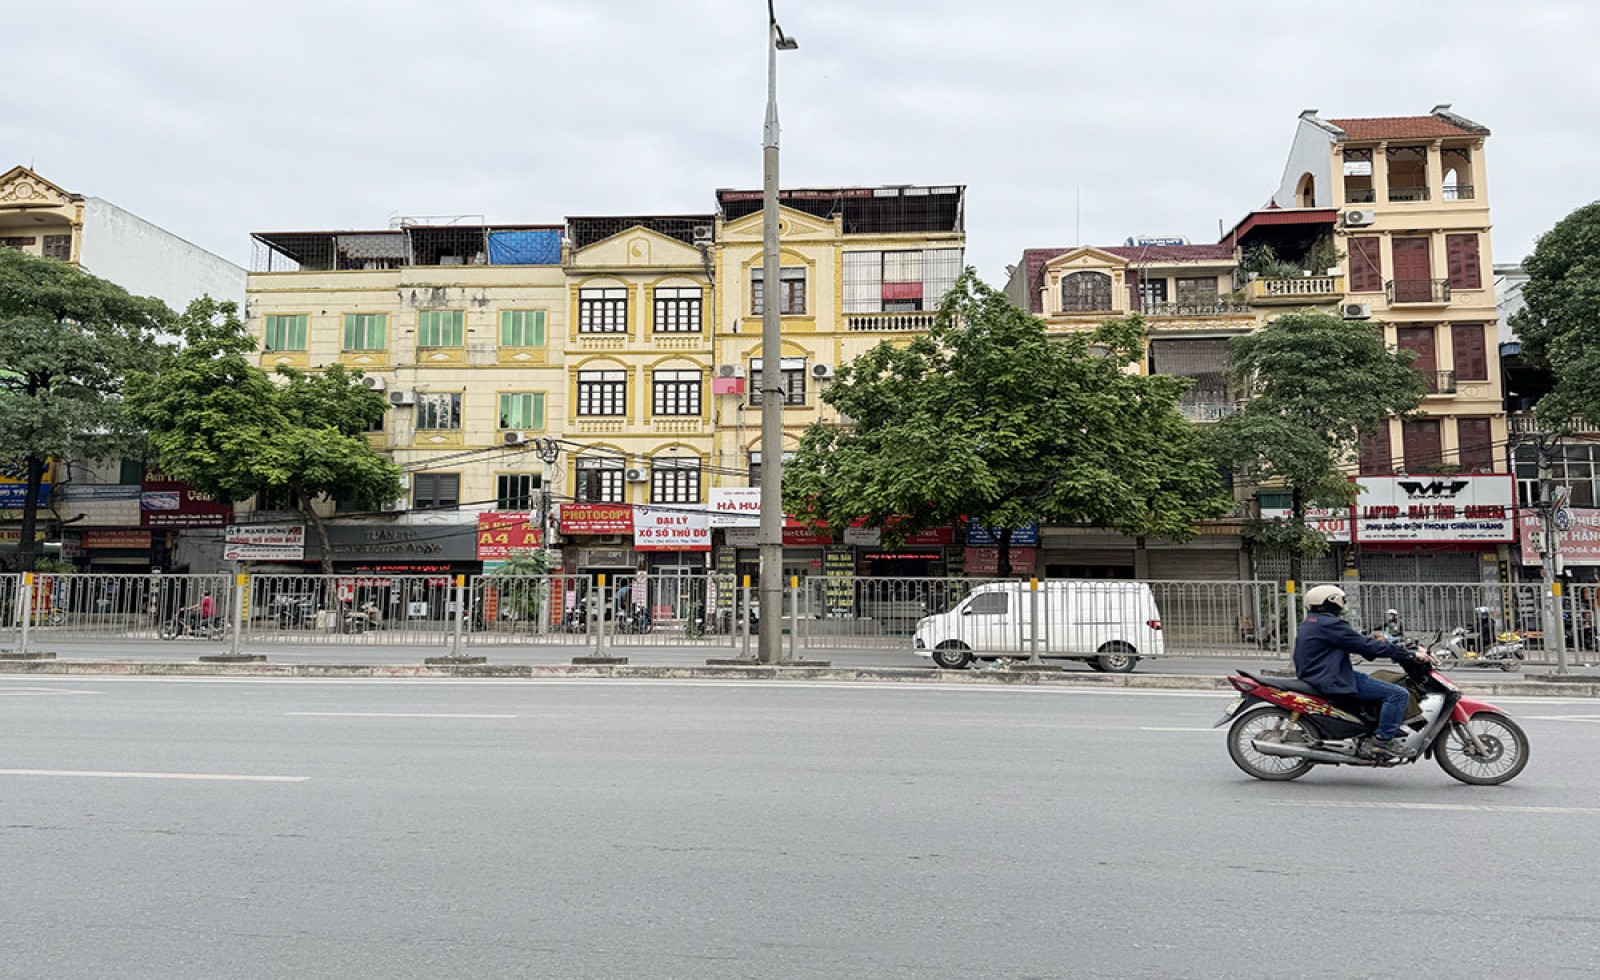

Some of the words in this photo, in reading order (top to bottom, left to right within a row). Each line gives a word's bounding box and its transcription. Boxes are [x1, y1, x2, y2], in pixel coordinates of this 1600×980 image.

[739, 502, 760, 510] HU
[1364, 505, 1399, 519] LAPTOP
[1408, 502, 1430, 519] MÁY
[1433, 502, 1455, 519] TÍNH
[1464, 504, 1506, 519] CAMERA
[562, 510, 632, 520] PHOTOCOPY
[656, 517, 674, 526] ĐẠI
[676, 515, 688, 524] LÝ
[1365, 524, 1381, 532] PHỤ
[1424, 523, 1449, 532] THOẠI
[1450, 522, 1477, 530] CHÍNH
[480, 533, 510, 544] A4
